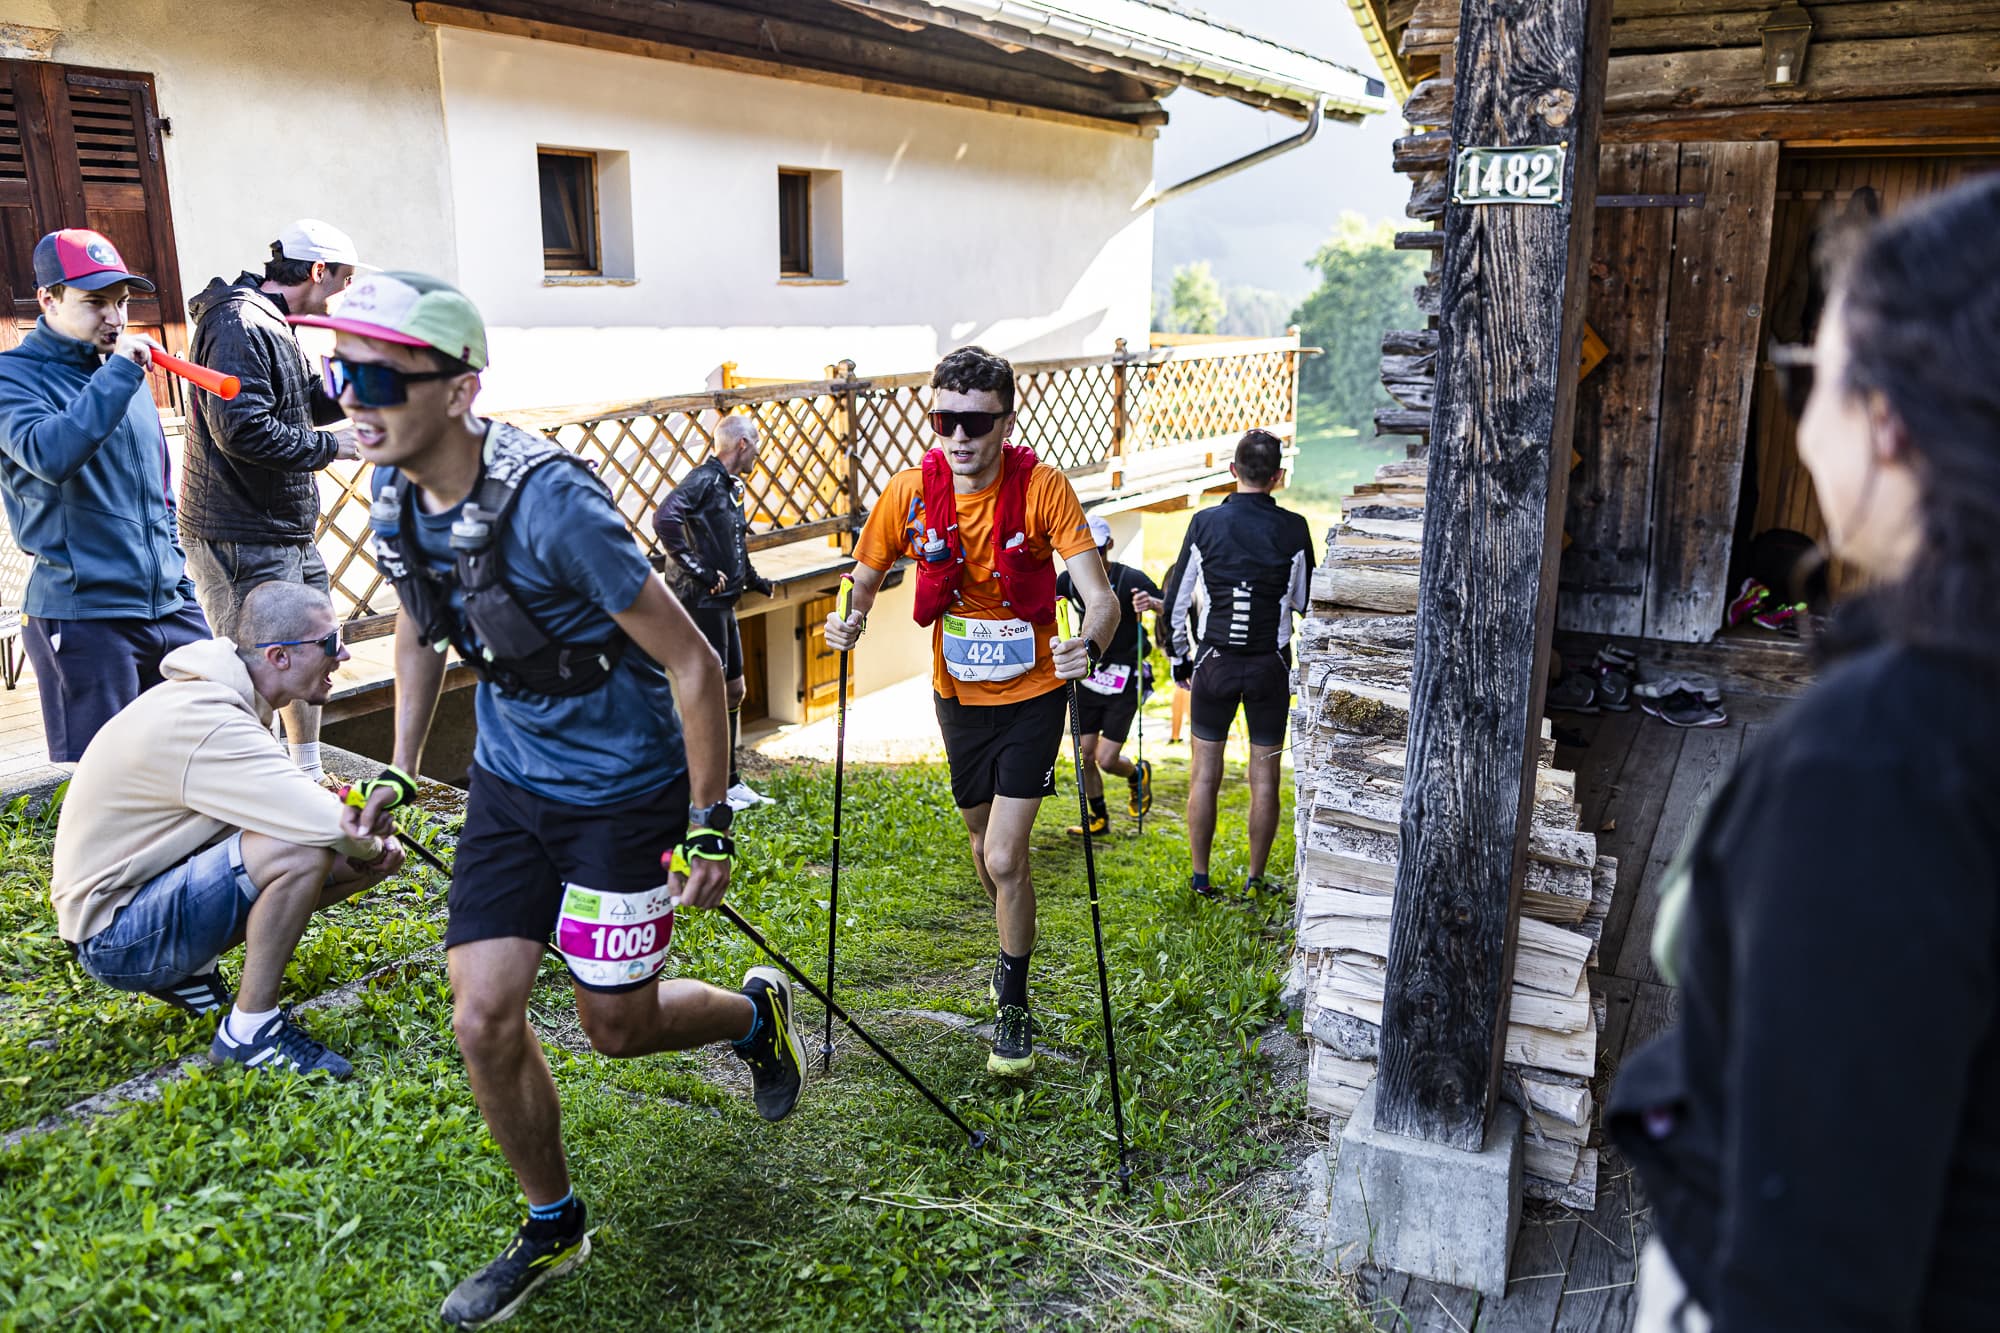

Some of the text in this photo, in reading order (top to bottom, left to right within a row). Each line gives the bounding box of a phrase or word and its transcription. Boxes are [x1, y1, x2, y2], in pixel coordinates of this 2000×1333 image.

[1467, 153, 1554, 198] 1482
[967, 642, 1006, 664] 424
[591, 923, 656, 959] 1009
